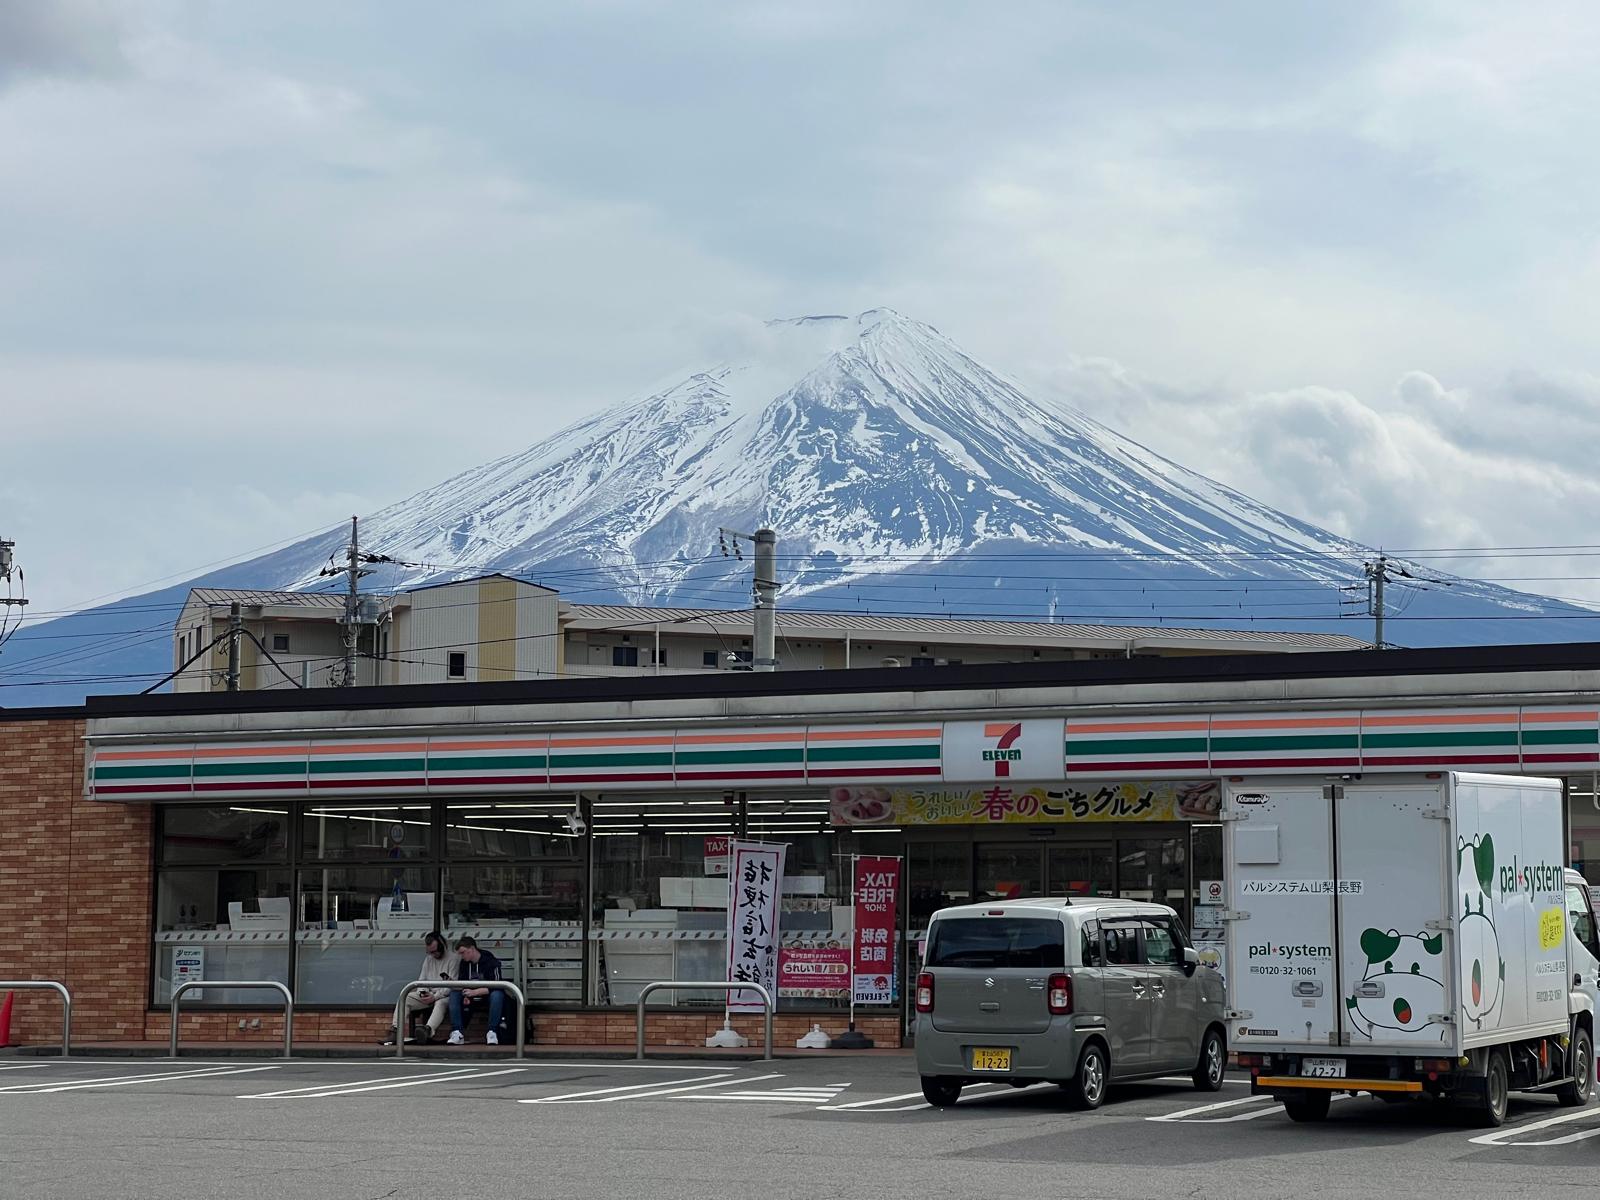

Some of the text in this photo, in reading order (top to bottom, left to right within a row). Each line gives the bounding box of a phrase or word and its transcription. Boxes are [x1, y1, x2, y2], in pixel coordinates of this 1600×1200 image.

[984, 723, 1021, 776] 7
[972, 786, 1154, 820] 春のごちグルメ
